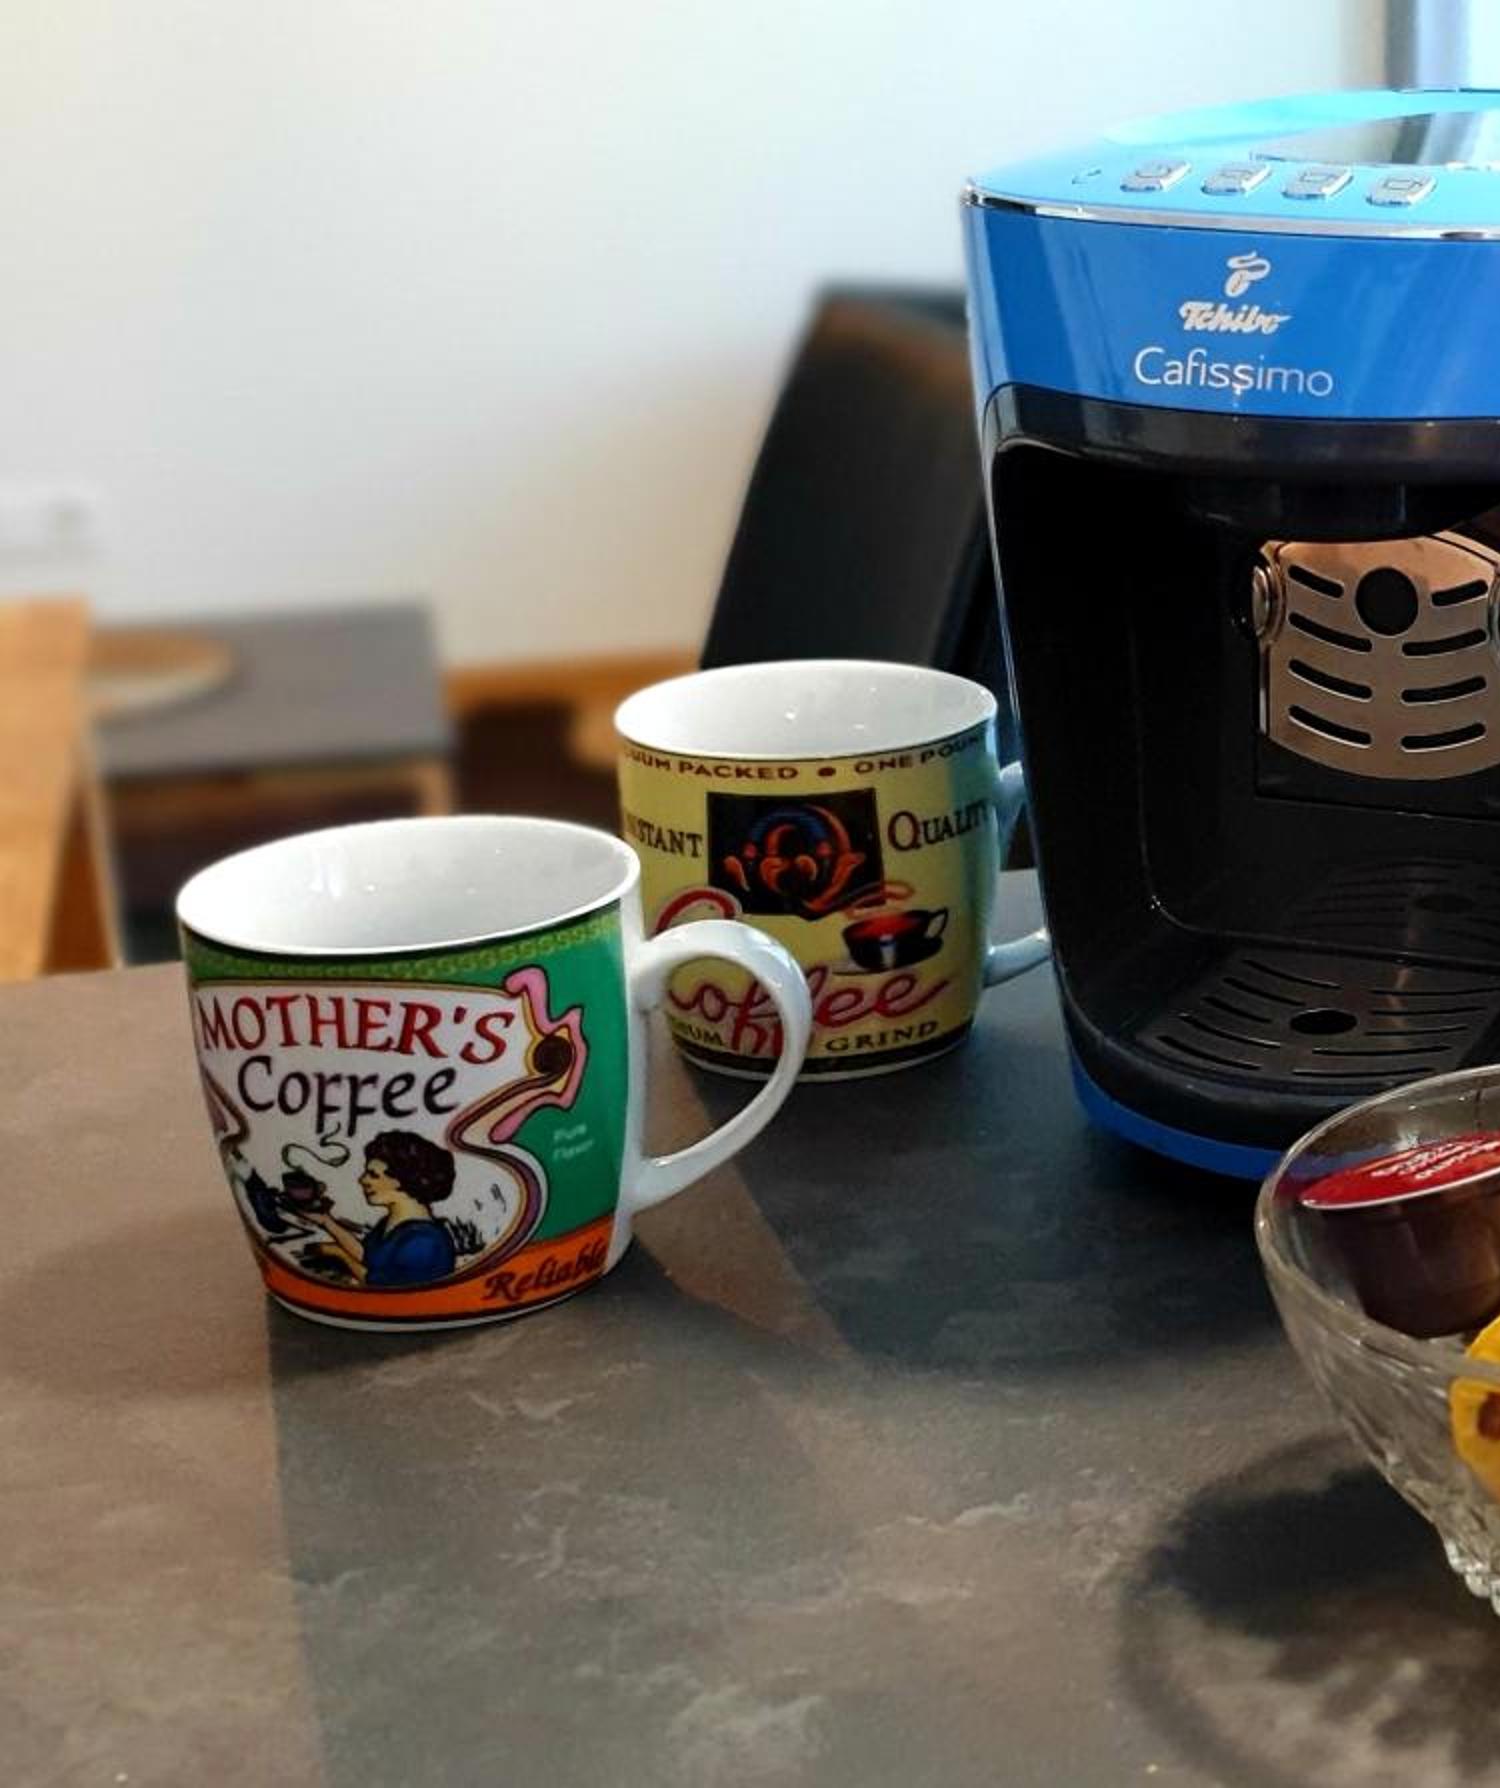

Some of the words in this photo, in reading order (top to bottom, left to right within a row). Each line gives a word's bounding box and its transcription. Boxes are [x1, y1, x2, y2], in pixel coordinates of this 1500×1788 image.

[1178, 301, 1293, 335] Tchibo
[1134, 346, 1334, 396] Cafissimo
[626, 748, 671, 772] UUM
[678, 760, 798, 780] PACKED
[854, 754, 914, 774] ONE
[197, 994, 516, 1065] MOTHER'S
[825, 1020, 940, 1051] GRIND
